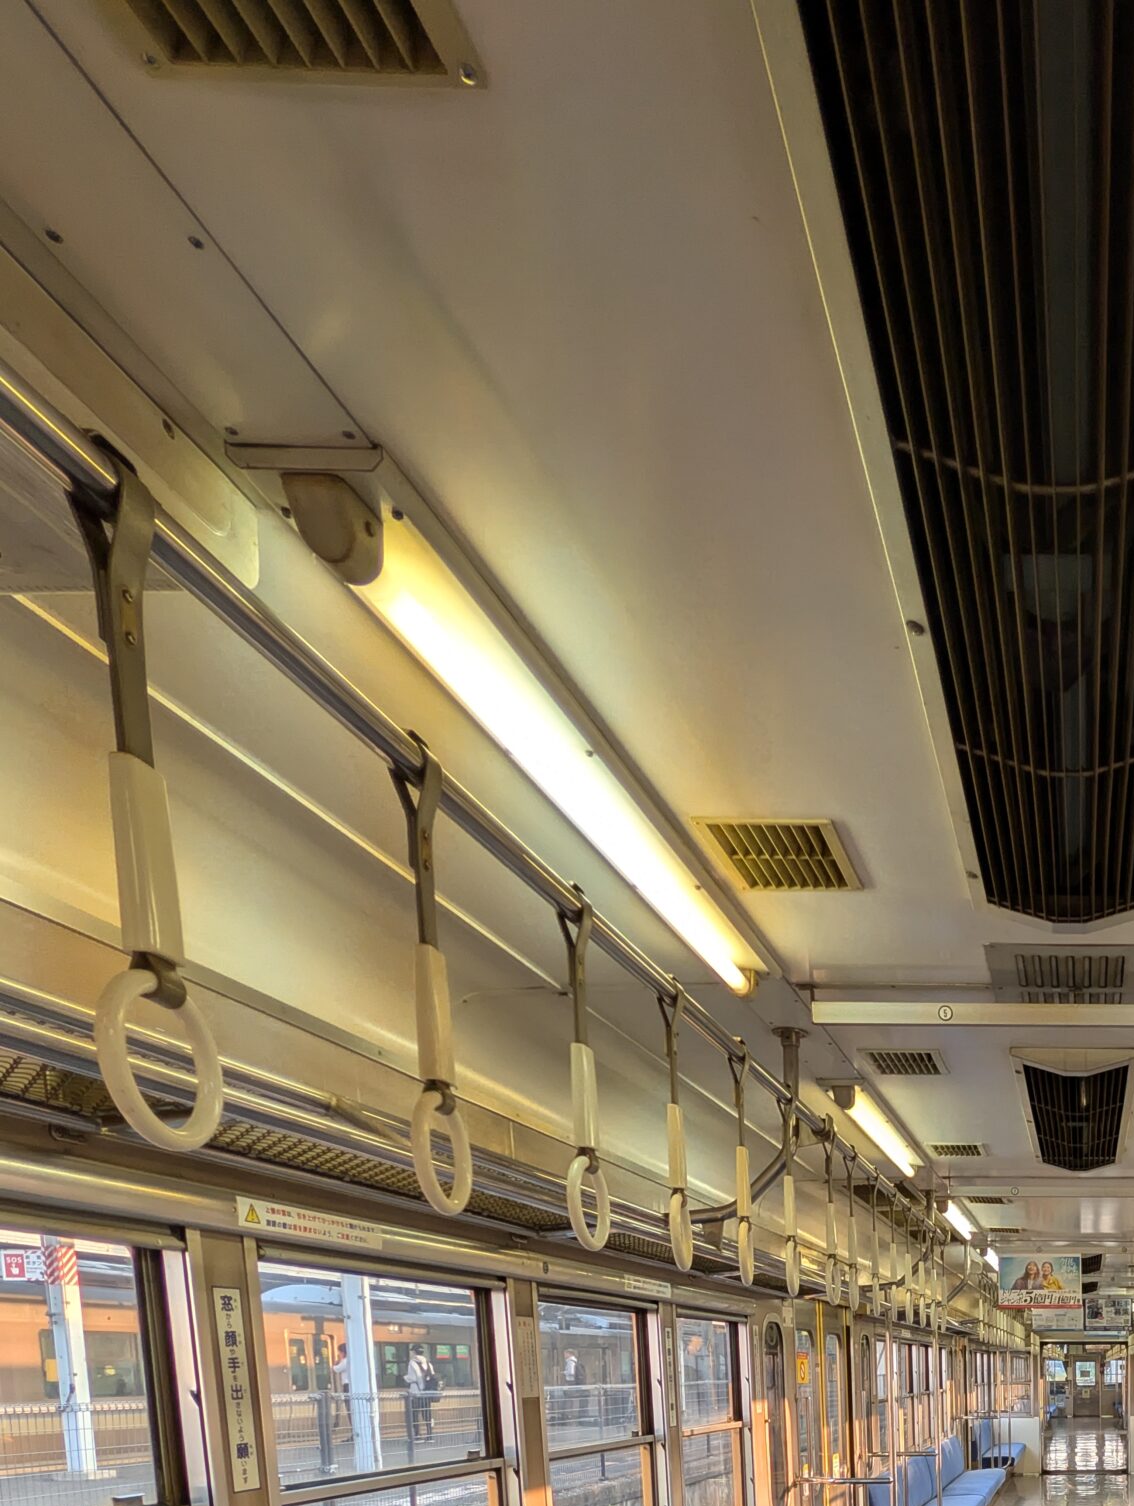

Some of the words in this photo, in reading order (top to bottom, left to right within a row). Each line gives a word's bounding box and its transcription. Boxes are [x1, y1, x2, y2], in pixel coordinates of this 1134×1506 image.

[220, 1294, 249, 1485] 窓から顔や手を出さないよう願います
